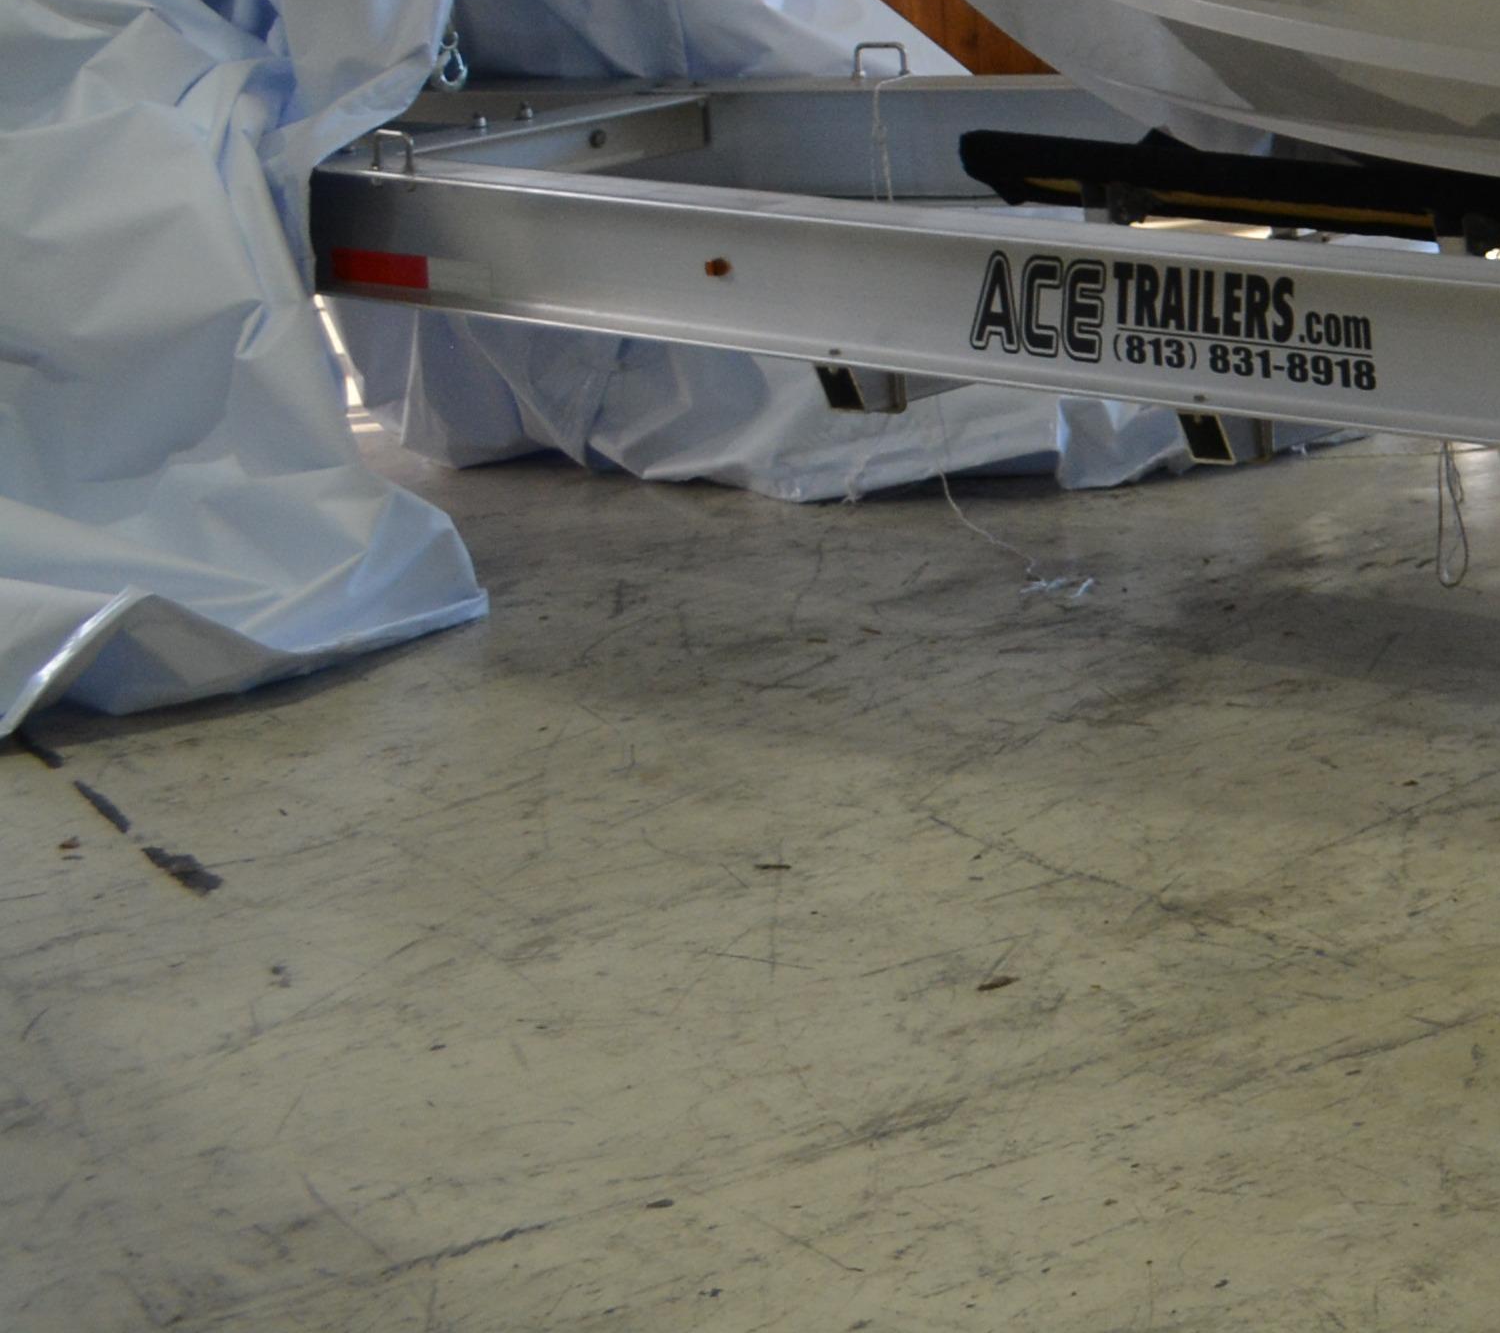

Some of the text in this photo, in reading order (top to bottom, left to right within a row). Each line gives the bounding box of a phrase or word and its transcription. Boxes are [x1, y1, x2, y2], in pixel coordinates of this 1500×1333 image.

[970, 250, 1106, 364] ACE
[1113, 334, 1377, 391] (813) 831-8918
